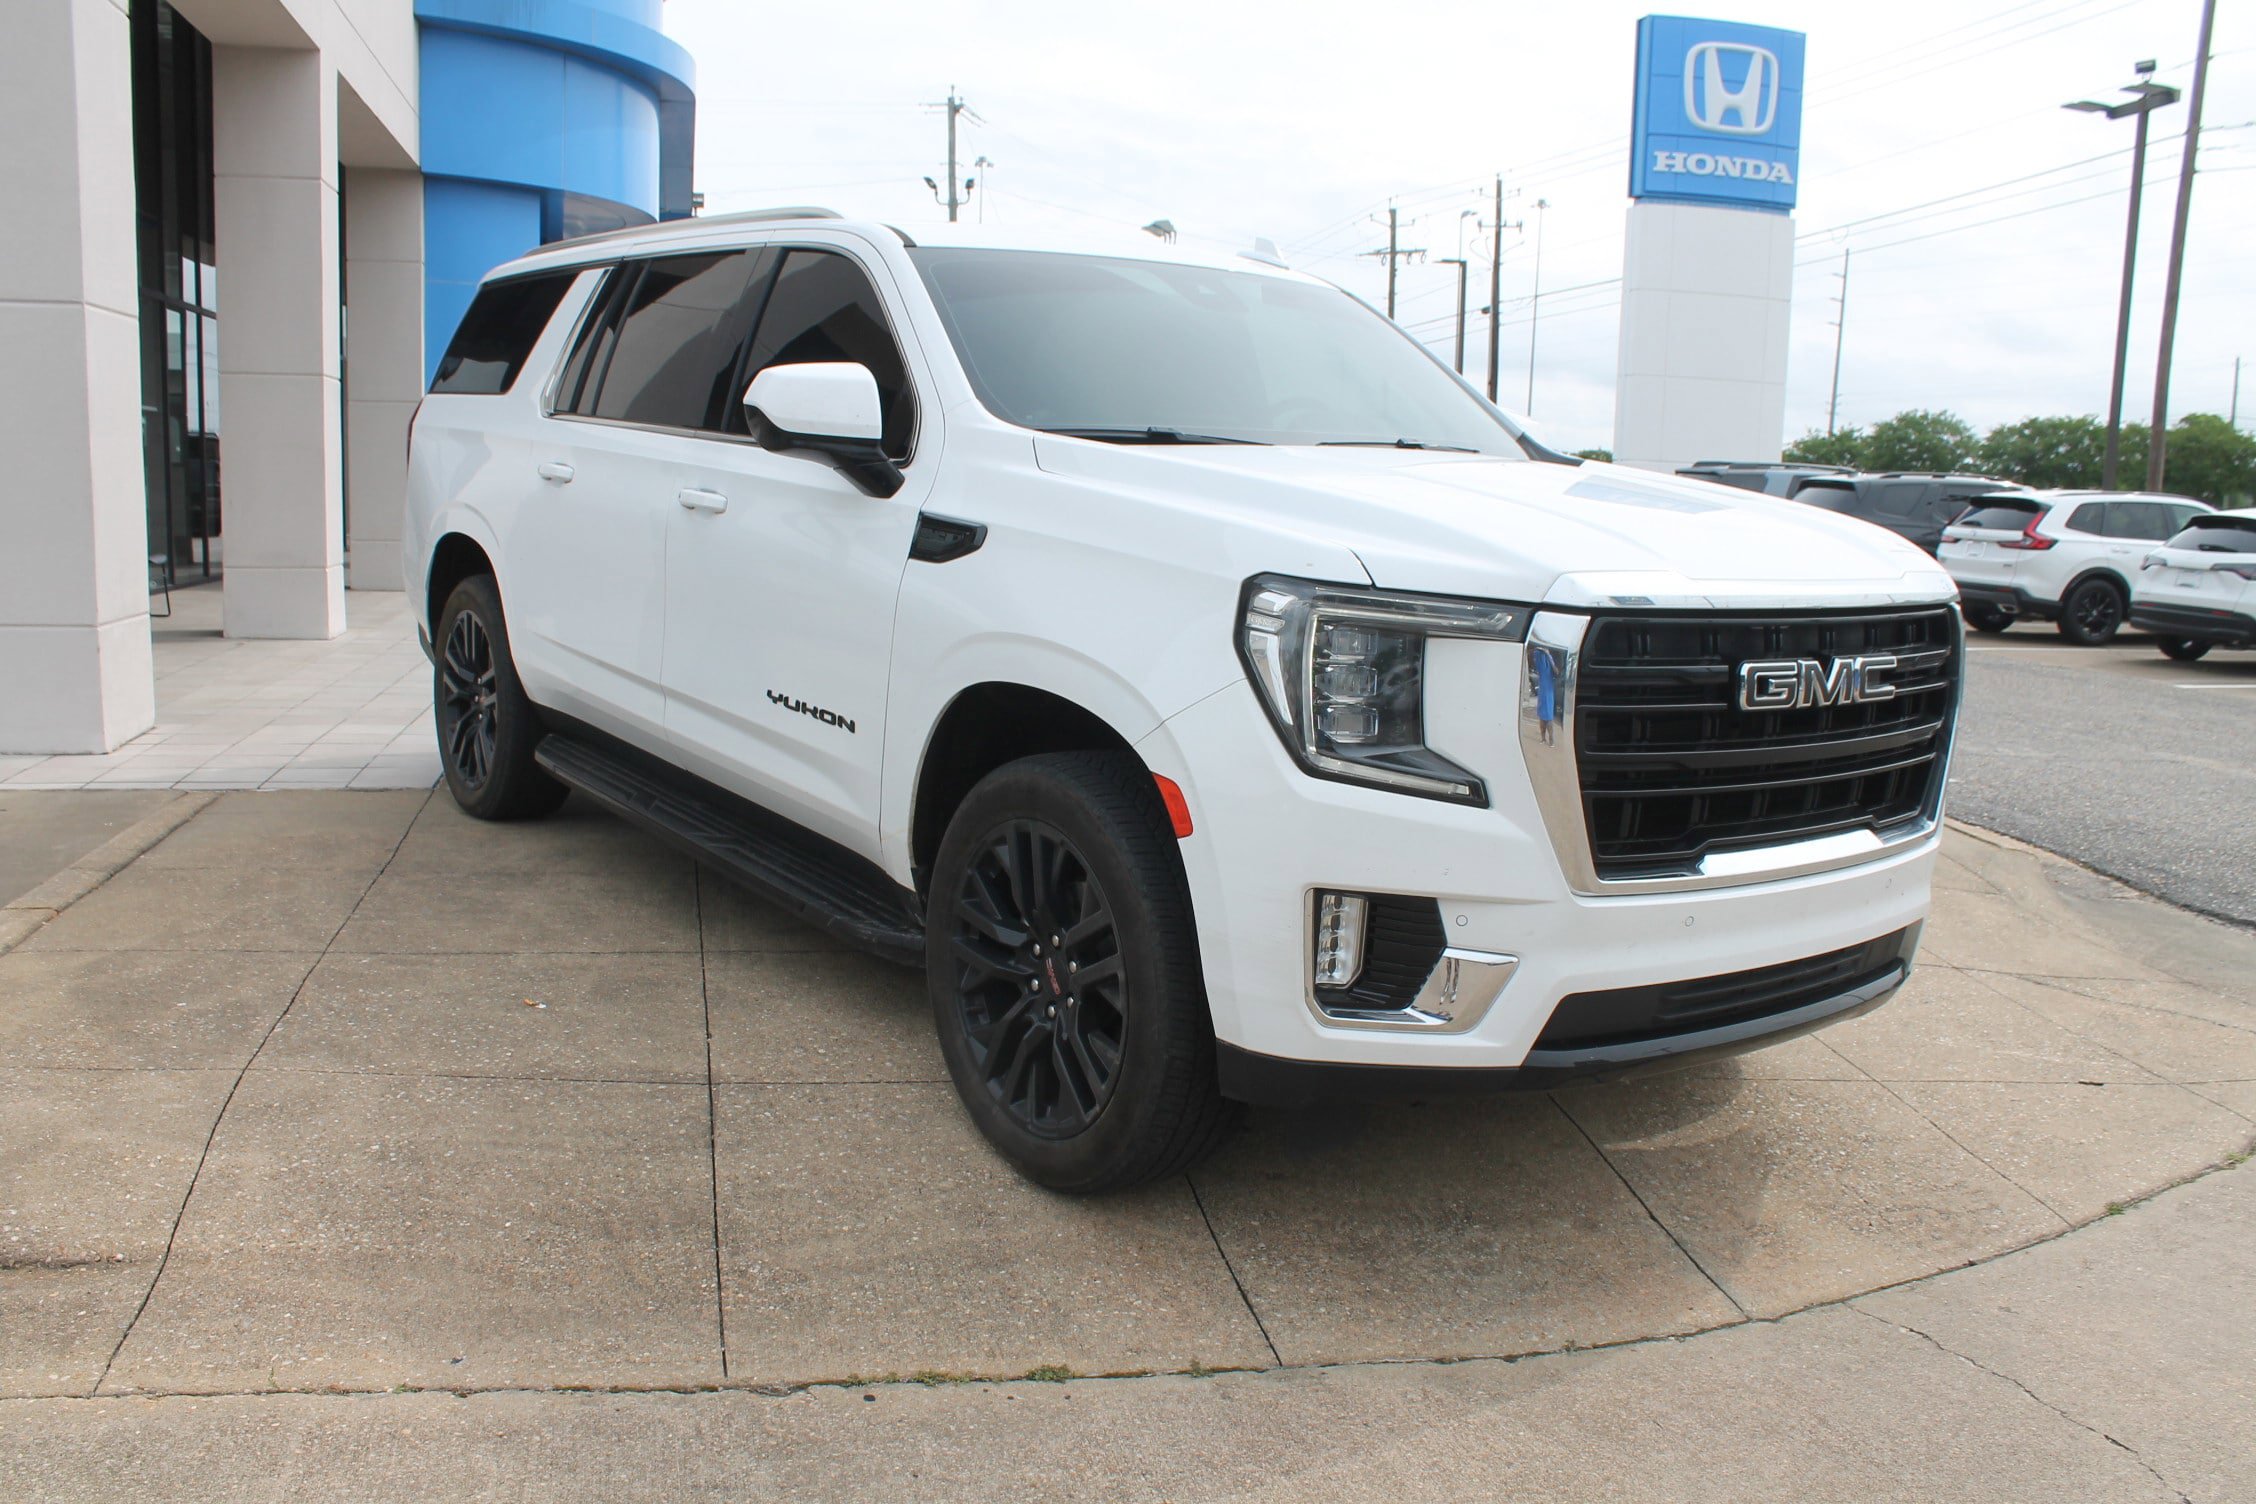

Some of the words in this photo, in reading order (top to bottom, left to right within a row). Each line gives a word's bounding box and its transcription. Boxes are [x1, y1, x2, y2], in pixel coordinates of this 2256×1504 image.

[1653, 151, 1794, 184] HONDA
[1739, 656, 1897, 711] GMC
[766, 689, 856, 734] YUKON
